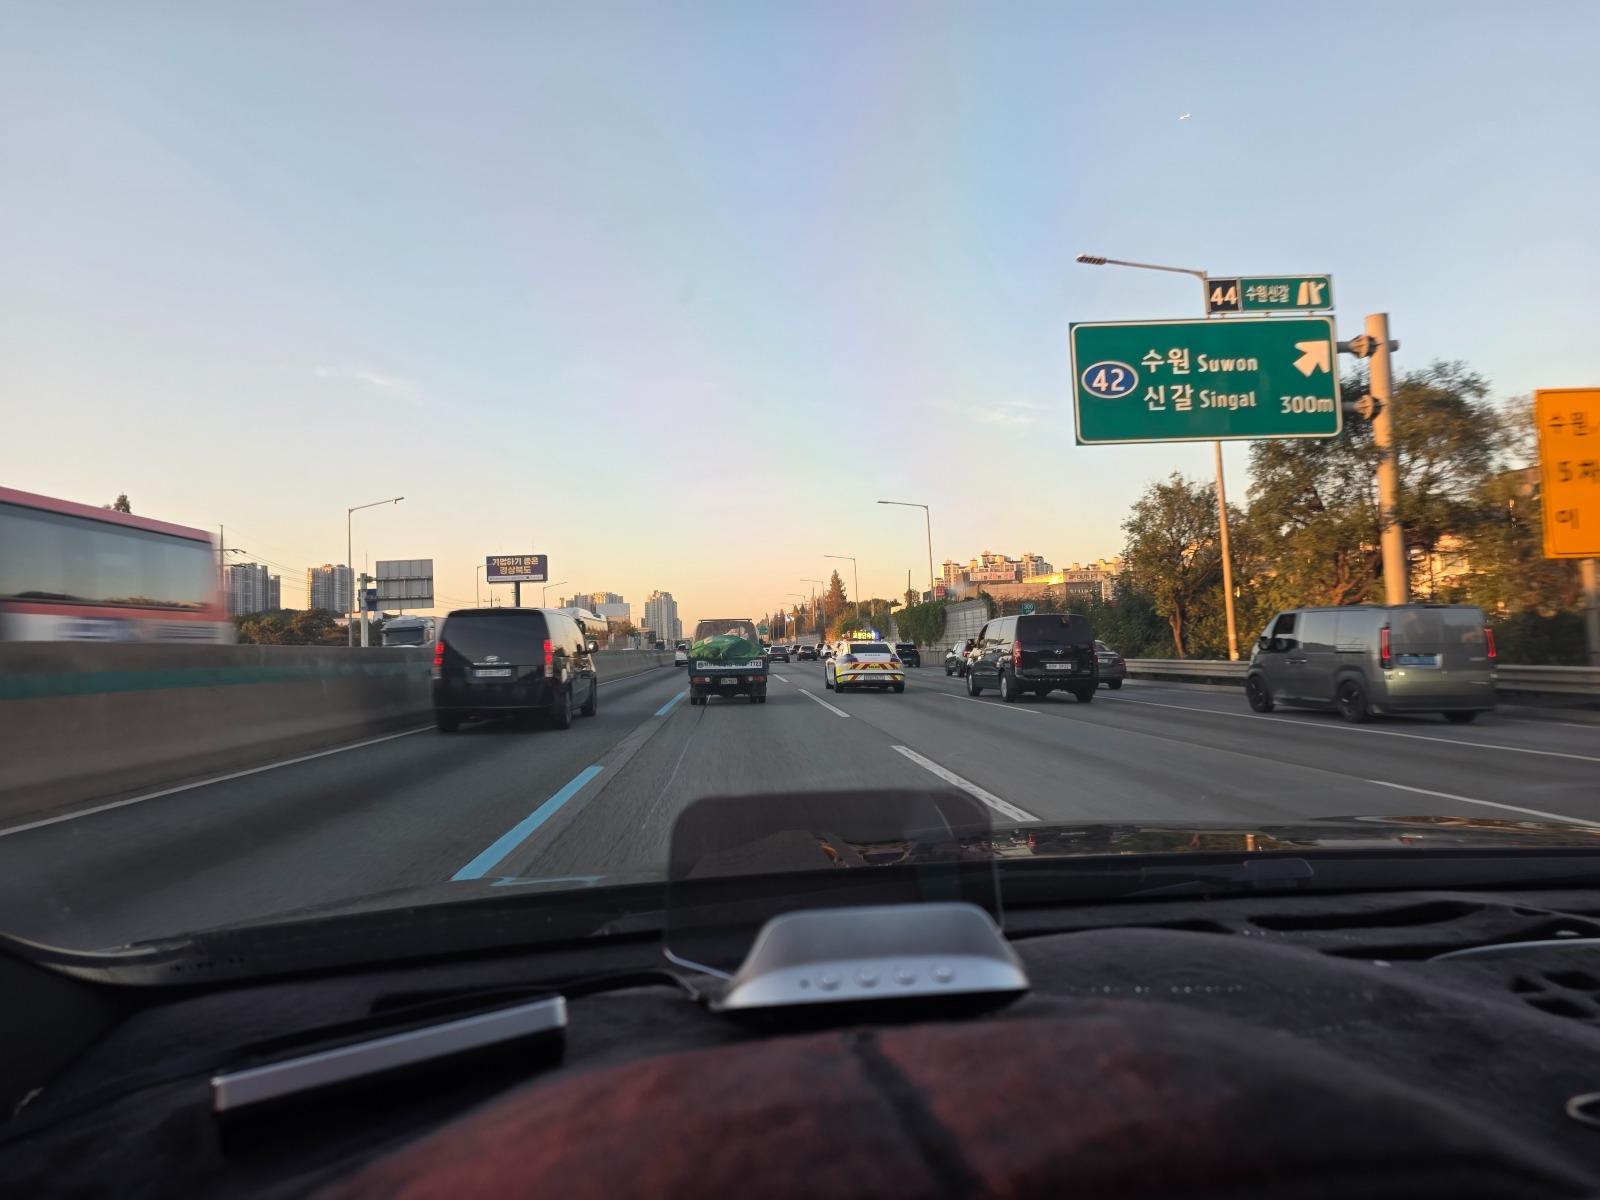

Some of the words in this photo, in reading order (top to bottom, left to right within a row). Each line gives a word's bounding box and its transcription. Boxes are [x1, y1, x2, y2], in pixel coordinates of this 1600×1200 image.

[1210, 286, 1237, 306] 44
[1245, 284, 1289, 303] 수원신갈
[1141, 347, 1190, 375] 수원
[1197, 354, 1258, 373] Suwon
[1092, 367, 1125, 392] 42
[1144, 384, 1194, 411] 신갈
[1199, 390, 1256, 411] Singal
[1280, 395, 1334, 414] 300m
[492, 557, 522, 566] 기업하기
[523, 556, 539, 566] 좋은
[500, 566, 531, 575] 경상북도
